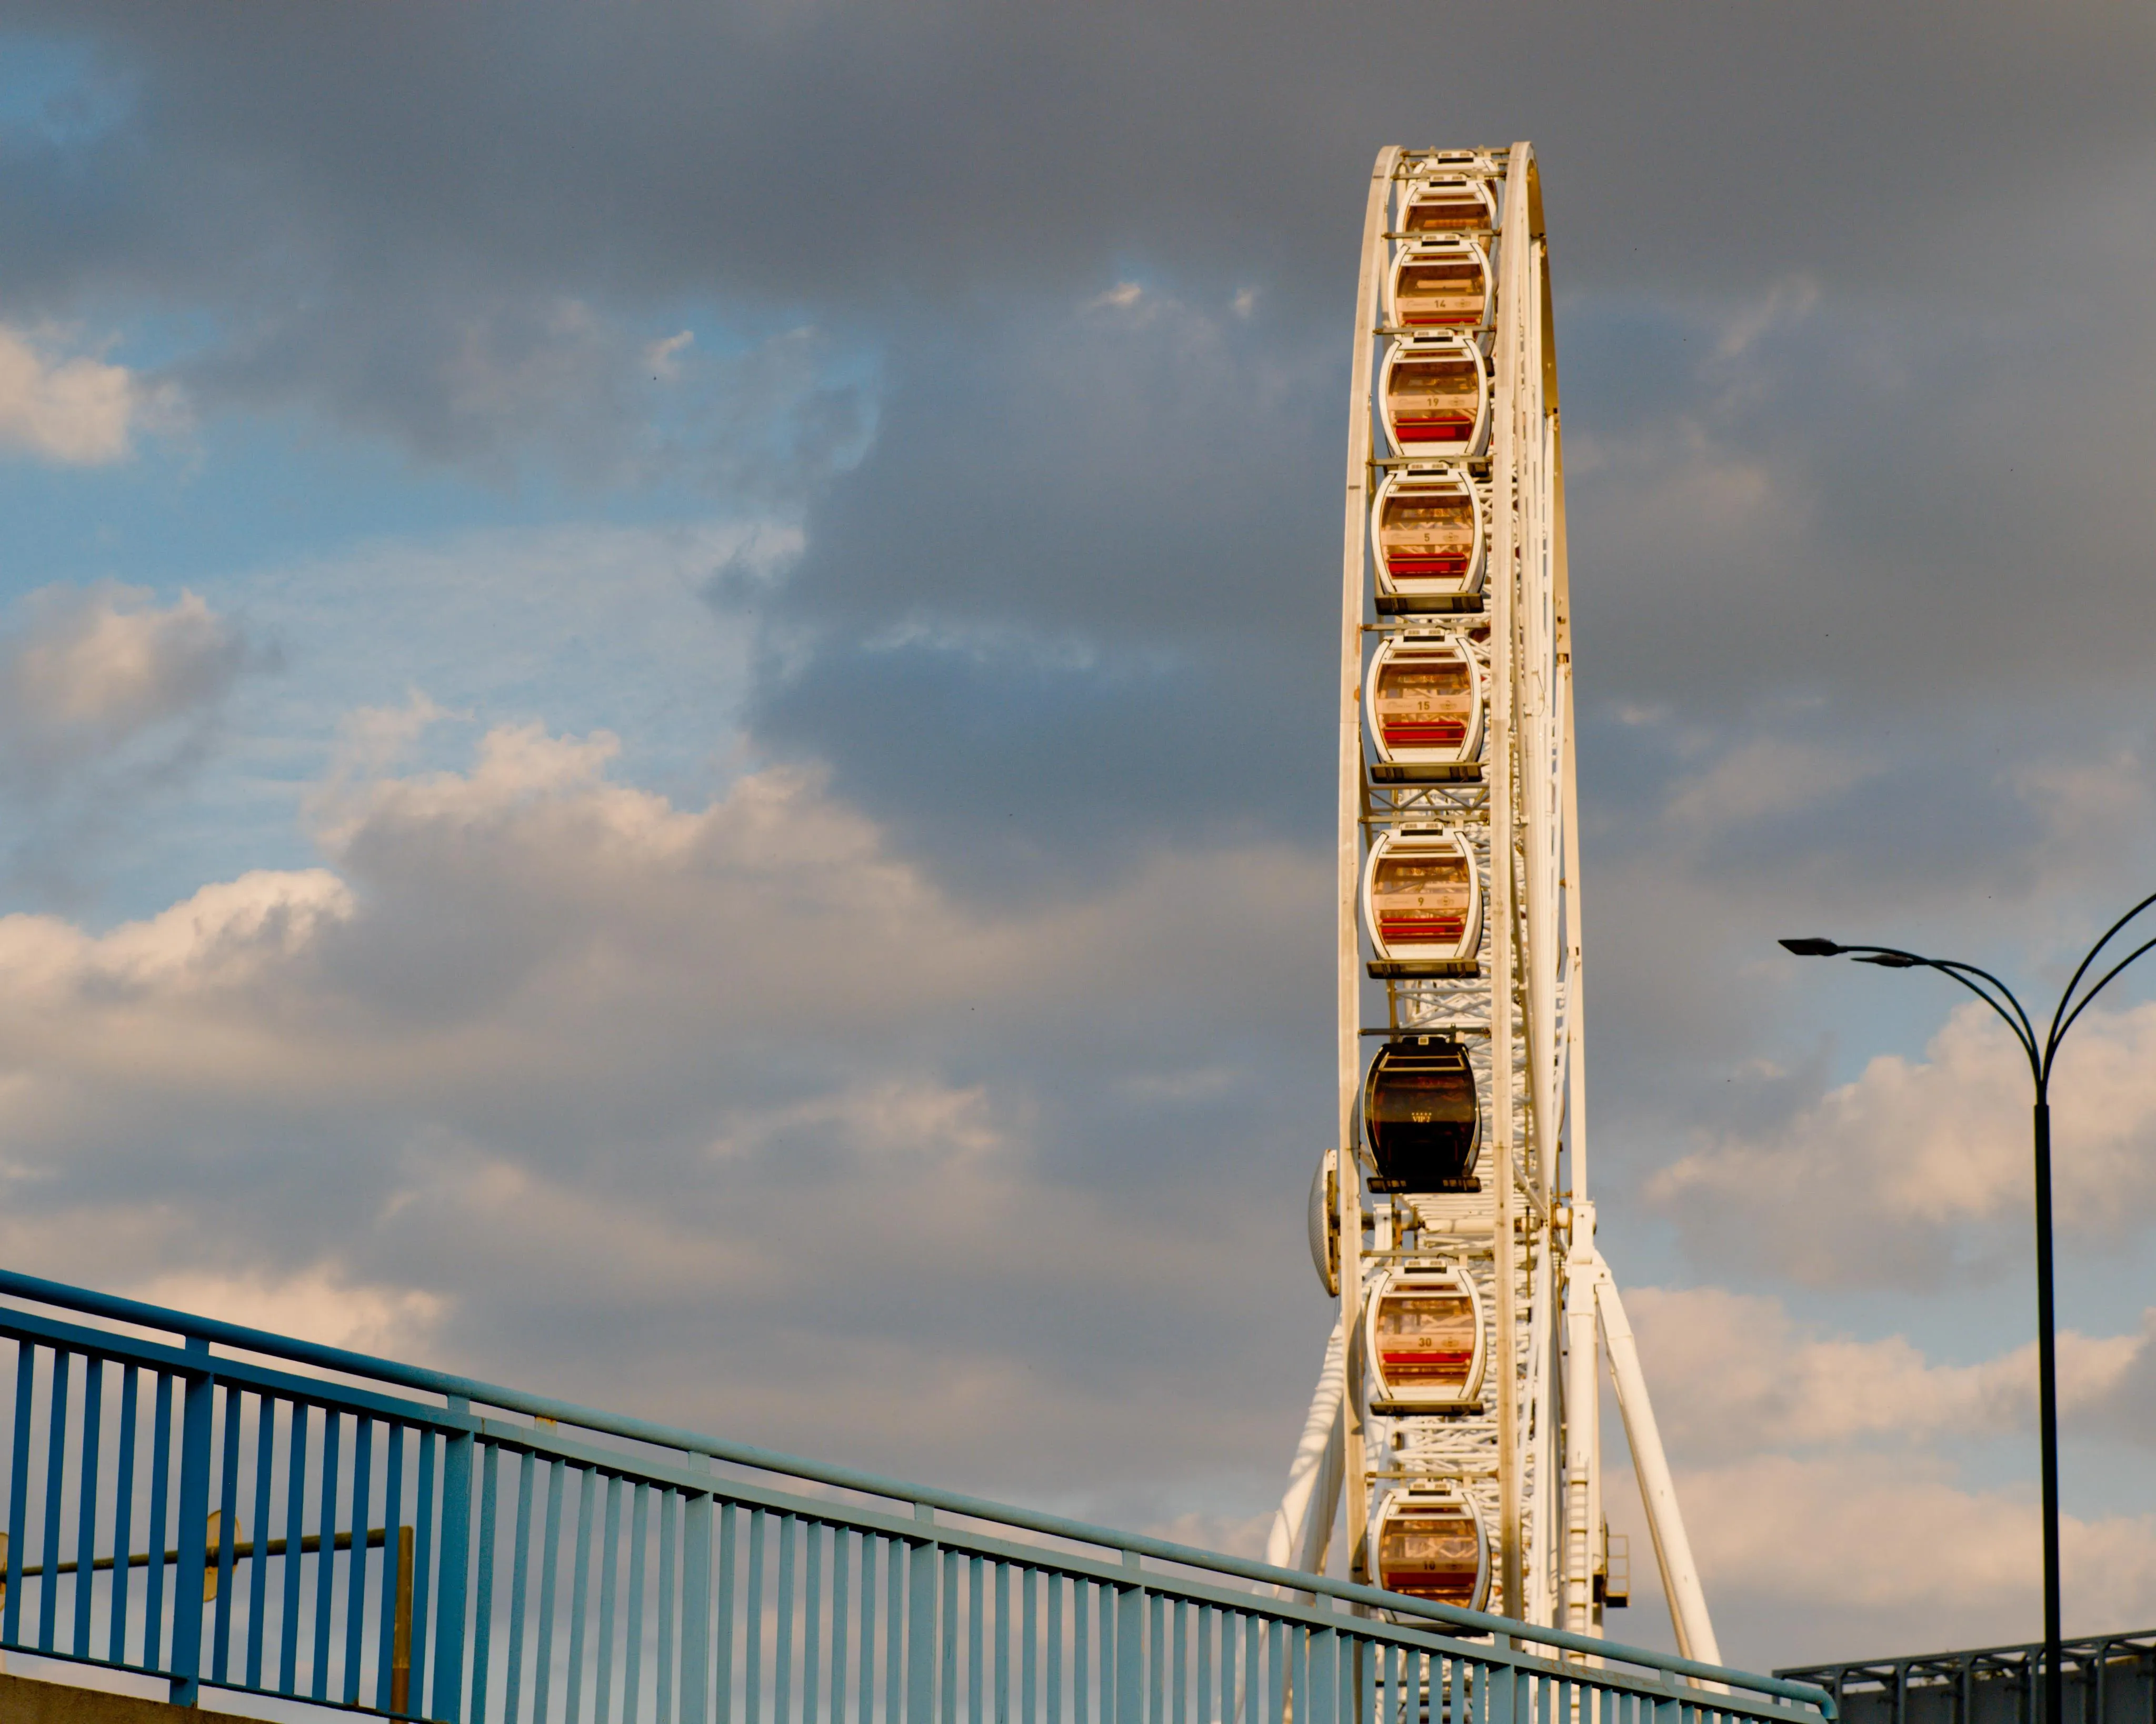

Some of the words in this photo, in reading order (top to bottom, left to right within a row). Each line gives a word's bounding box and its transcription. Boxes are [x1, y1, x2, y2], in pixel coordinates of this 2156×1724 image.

[1434, 299, 1446, 308] 14
[1427, 398, 1439, 406] 19
[1424, 533, 1430, 542] 5
[1418, 701, 1430, 710] 15
[1418, 897, 1424, 906] 9
[1419, 1338, 1432, 1347] 30
